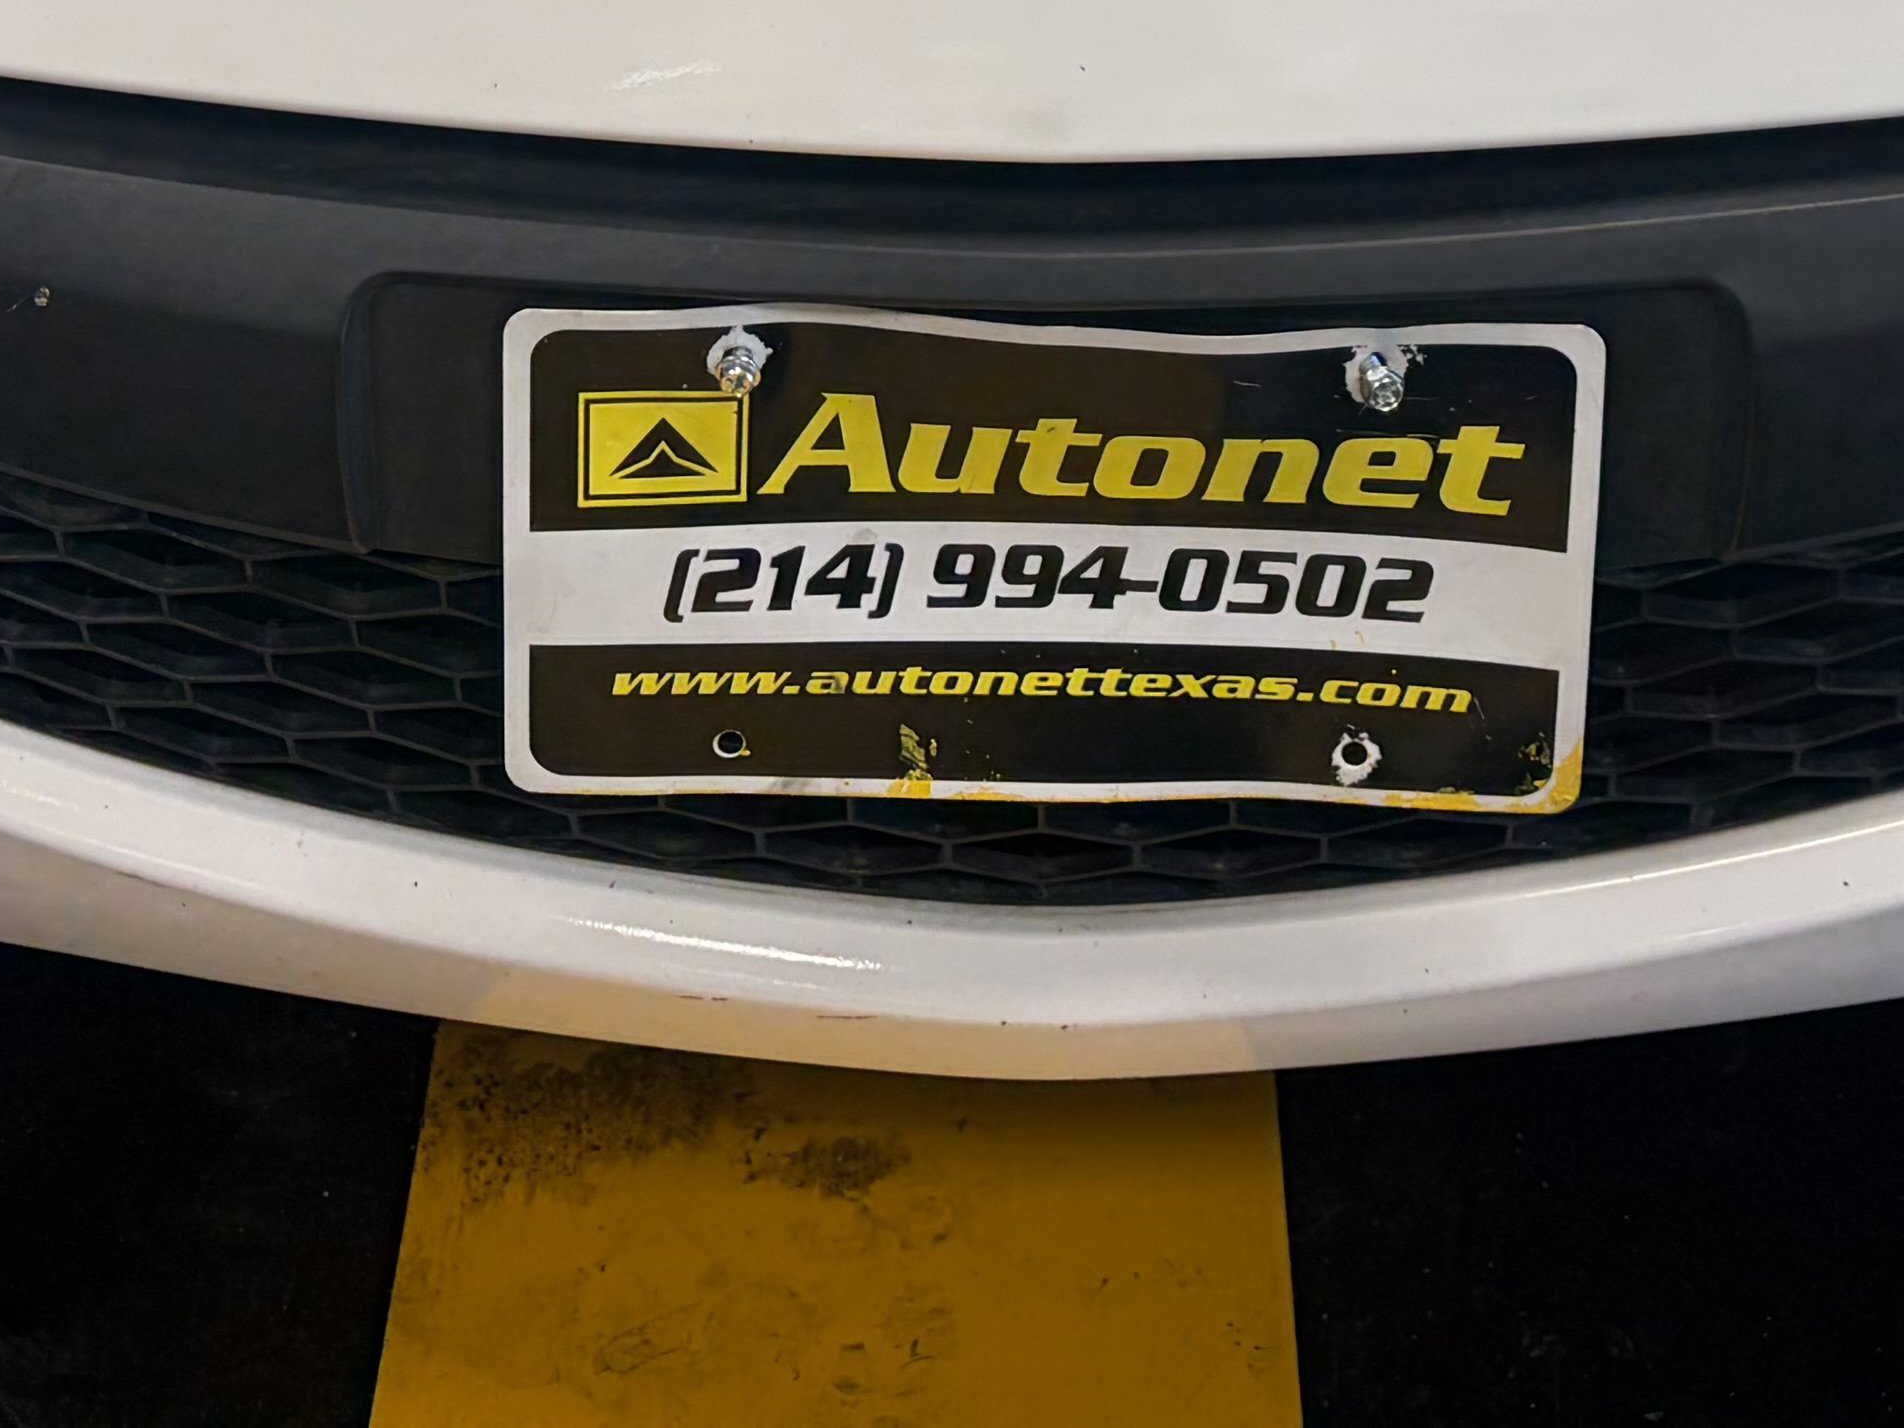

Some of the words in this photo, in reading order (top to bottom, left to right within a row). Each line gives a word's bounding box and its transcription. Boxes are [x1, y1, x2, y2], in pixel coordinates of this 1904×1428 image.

[758, 390, 1526, 517] Autonet
[663, 543, 905, 625] (214)
[926, 543, 1435, 623] 994-0502
[611, 665, 1472, 714] www.autonettexas.com
